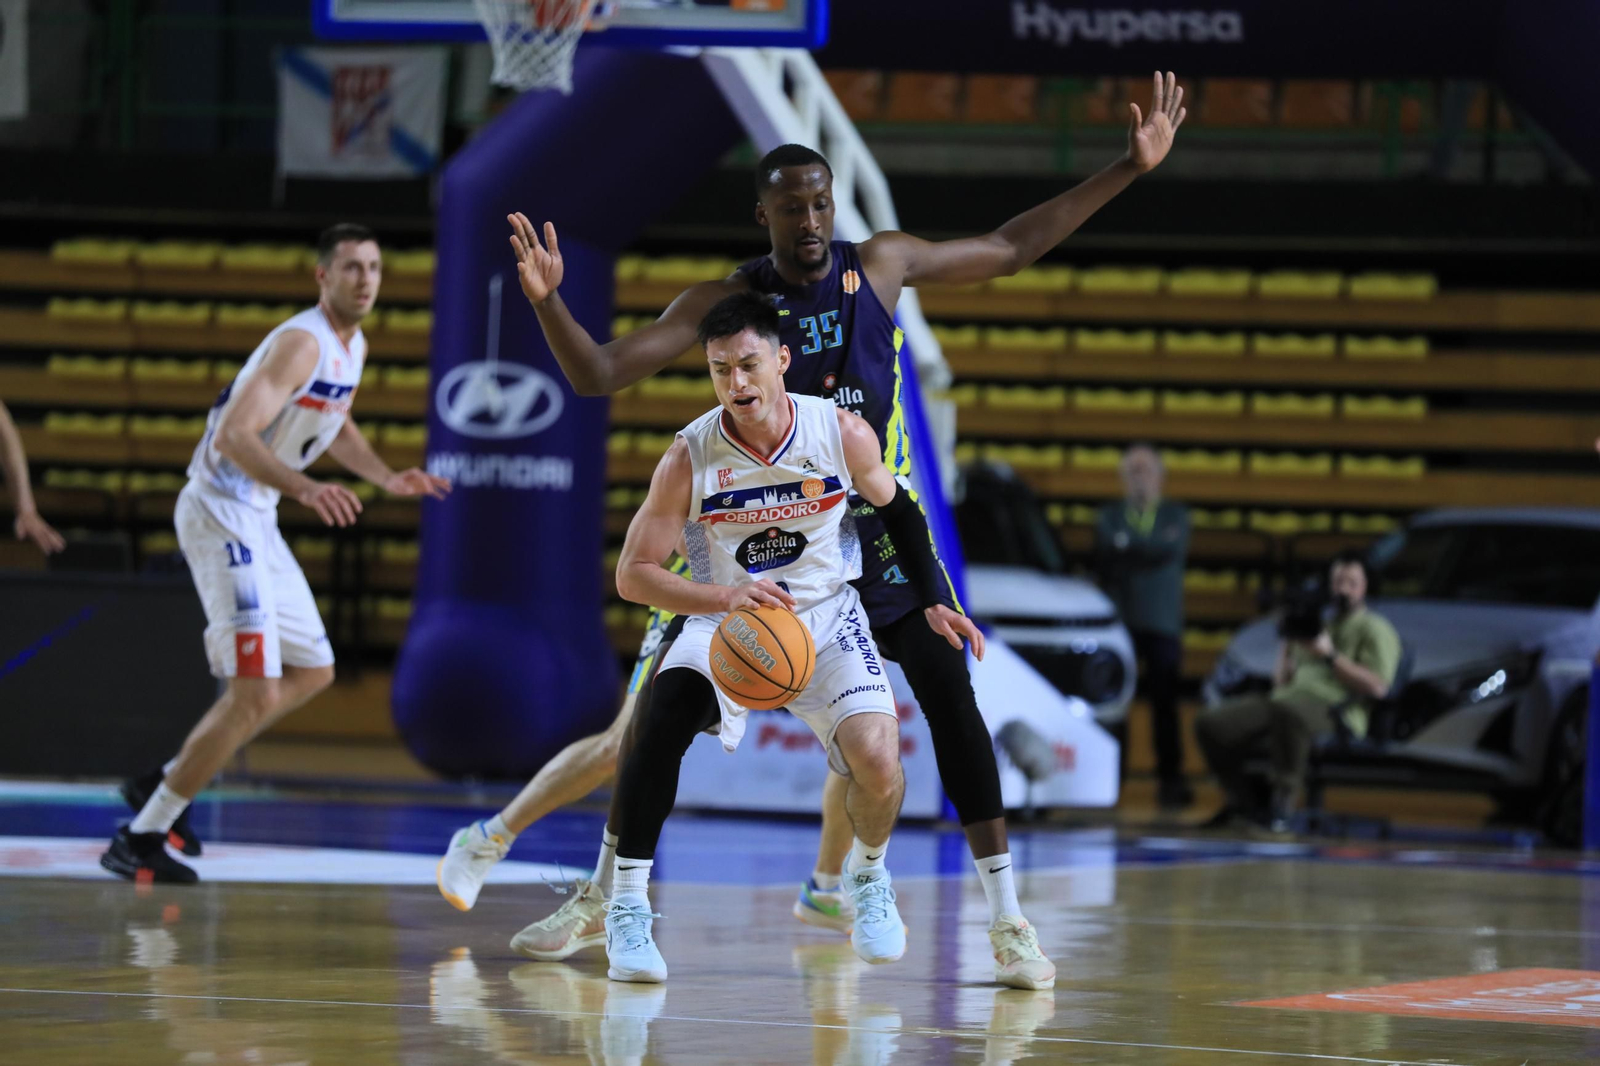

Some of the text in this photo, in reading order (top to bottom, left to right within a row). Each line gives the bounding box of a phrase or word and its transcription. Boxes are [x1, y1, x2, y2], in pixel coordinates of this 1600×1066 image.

[1012, 1, 1242, 46] Hyupersa
[799, 310, 843, 355] 35
[427, 453, 573, 490] HYUNDAI
[725, 501, 820, 523] OBRADOIRO
[225, 541, 252, 567] 16
[726, 615, 777, 673] Wilson
